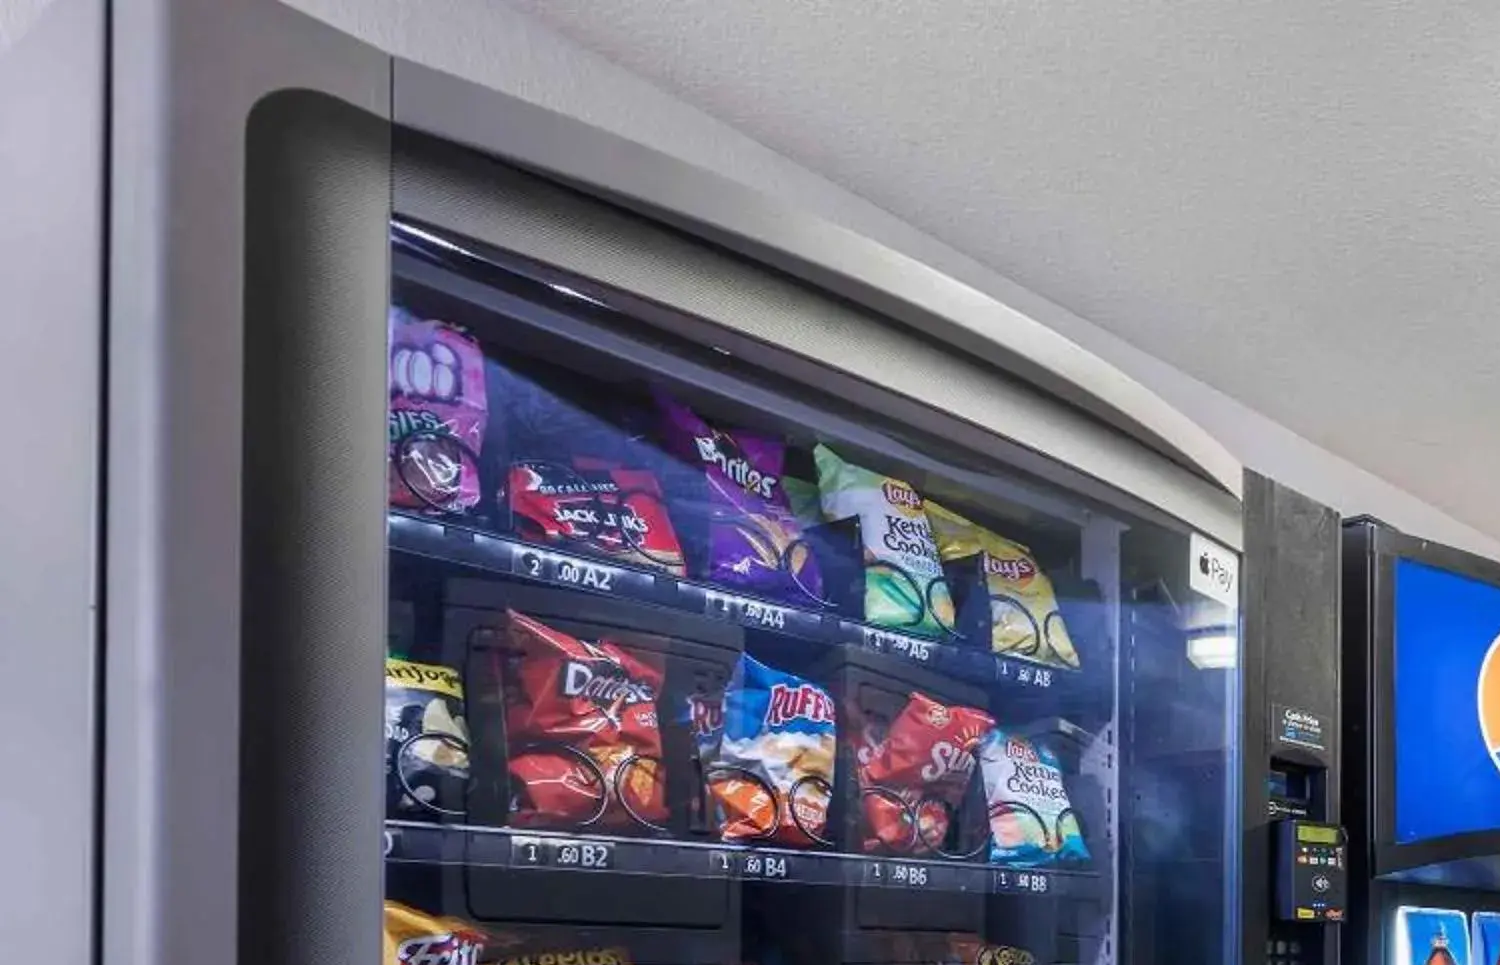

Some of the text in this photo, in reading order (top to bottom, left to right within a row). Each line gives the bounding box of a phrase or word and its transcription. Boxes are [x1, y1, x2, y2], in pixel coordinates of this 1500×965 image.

[582, 565, 612, 590] A2
[1211, 557, 1234, 593] Pay
[760, 607, 786, 629] A4
[581, 845, 608, 867] B2
[764, 857, 788, 877] B4
